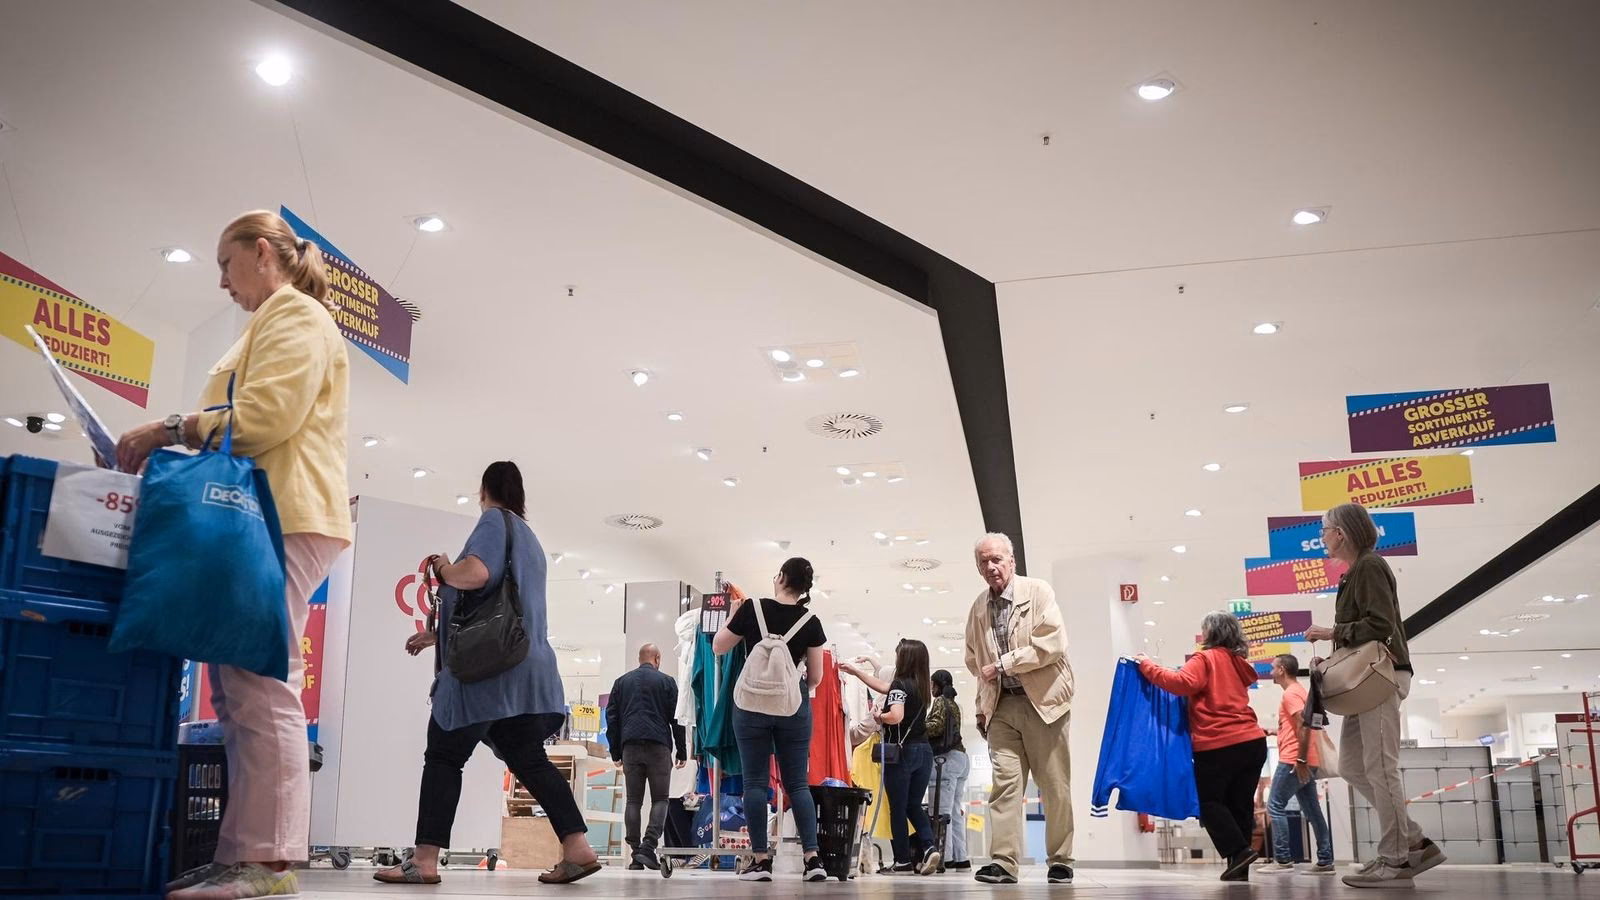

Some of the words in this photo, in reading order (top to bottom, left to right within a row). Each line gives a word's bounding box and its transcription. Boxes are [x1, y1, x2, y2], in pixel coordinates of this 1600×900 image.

[327, 287, 379, 320] ORTIMENTS-
[33, 298, 111, 346] ALLES
[1404, 392, 1489, 421] GROSSER
[1407, 408, 1492, 434] SORTIMENTS-
[1413, 419, 1495, 447] ABVERKAUF
[1348, 460, 1423, 492] ALLES
[1351, 482, 1427, 505] REDUZIERT!
[1292, 559, 1324, 572] ALLES
[1295, 568, 1326, 582] MUSS
[1297, 577, 1329, 592] RAUS!
[707, 595, 725, 606] -90%
[579, 707, 595, 715] -70%
